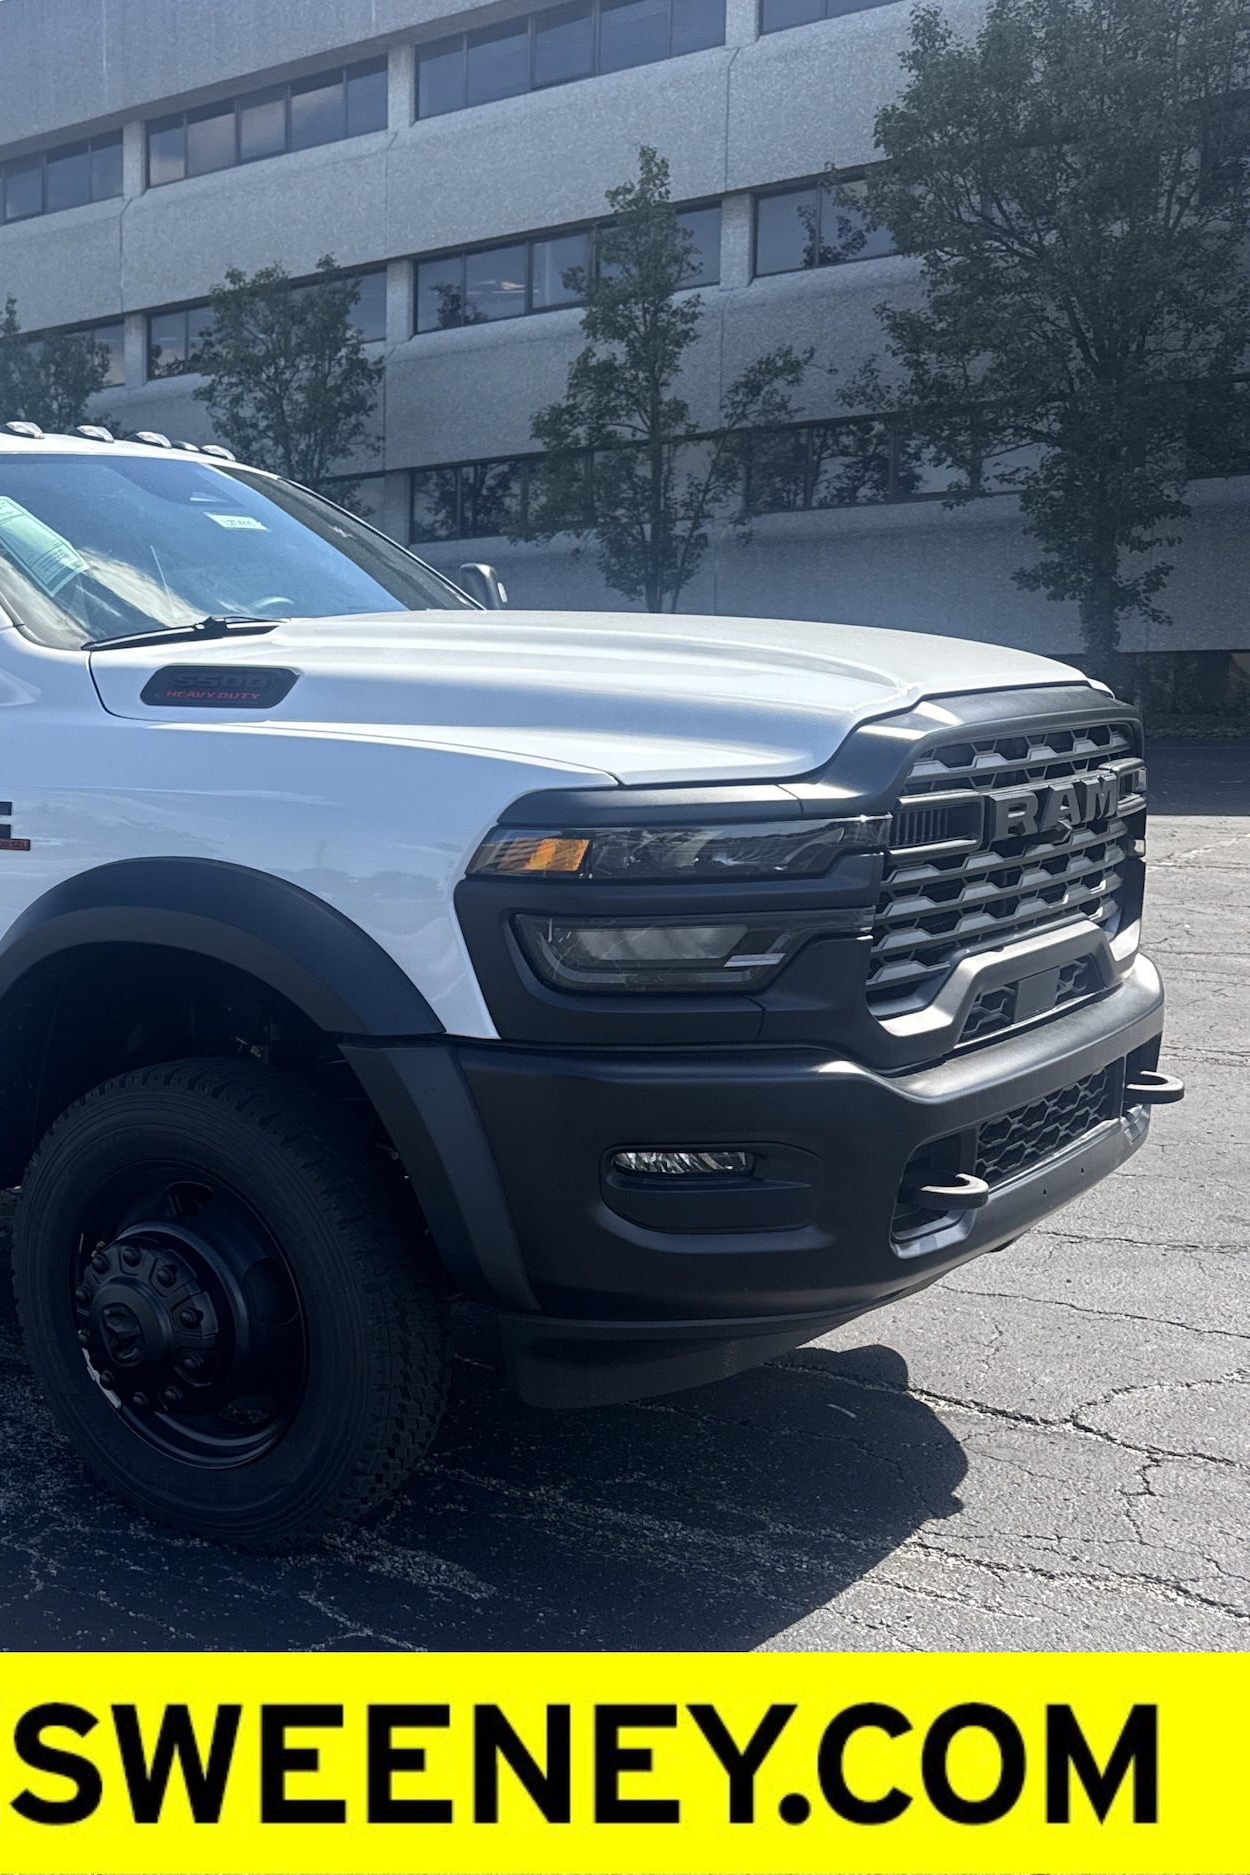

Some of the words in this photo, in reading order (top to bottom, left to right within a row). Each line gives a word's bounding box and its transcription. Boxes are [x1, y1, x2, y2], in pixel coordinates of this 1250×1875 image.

[166, 690, 215, 699] HEAVY
[217, 691, 261, 700] DUTY
[991, 772, 1119, 841] RAM
